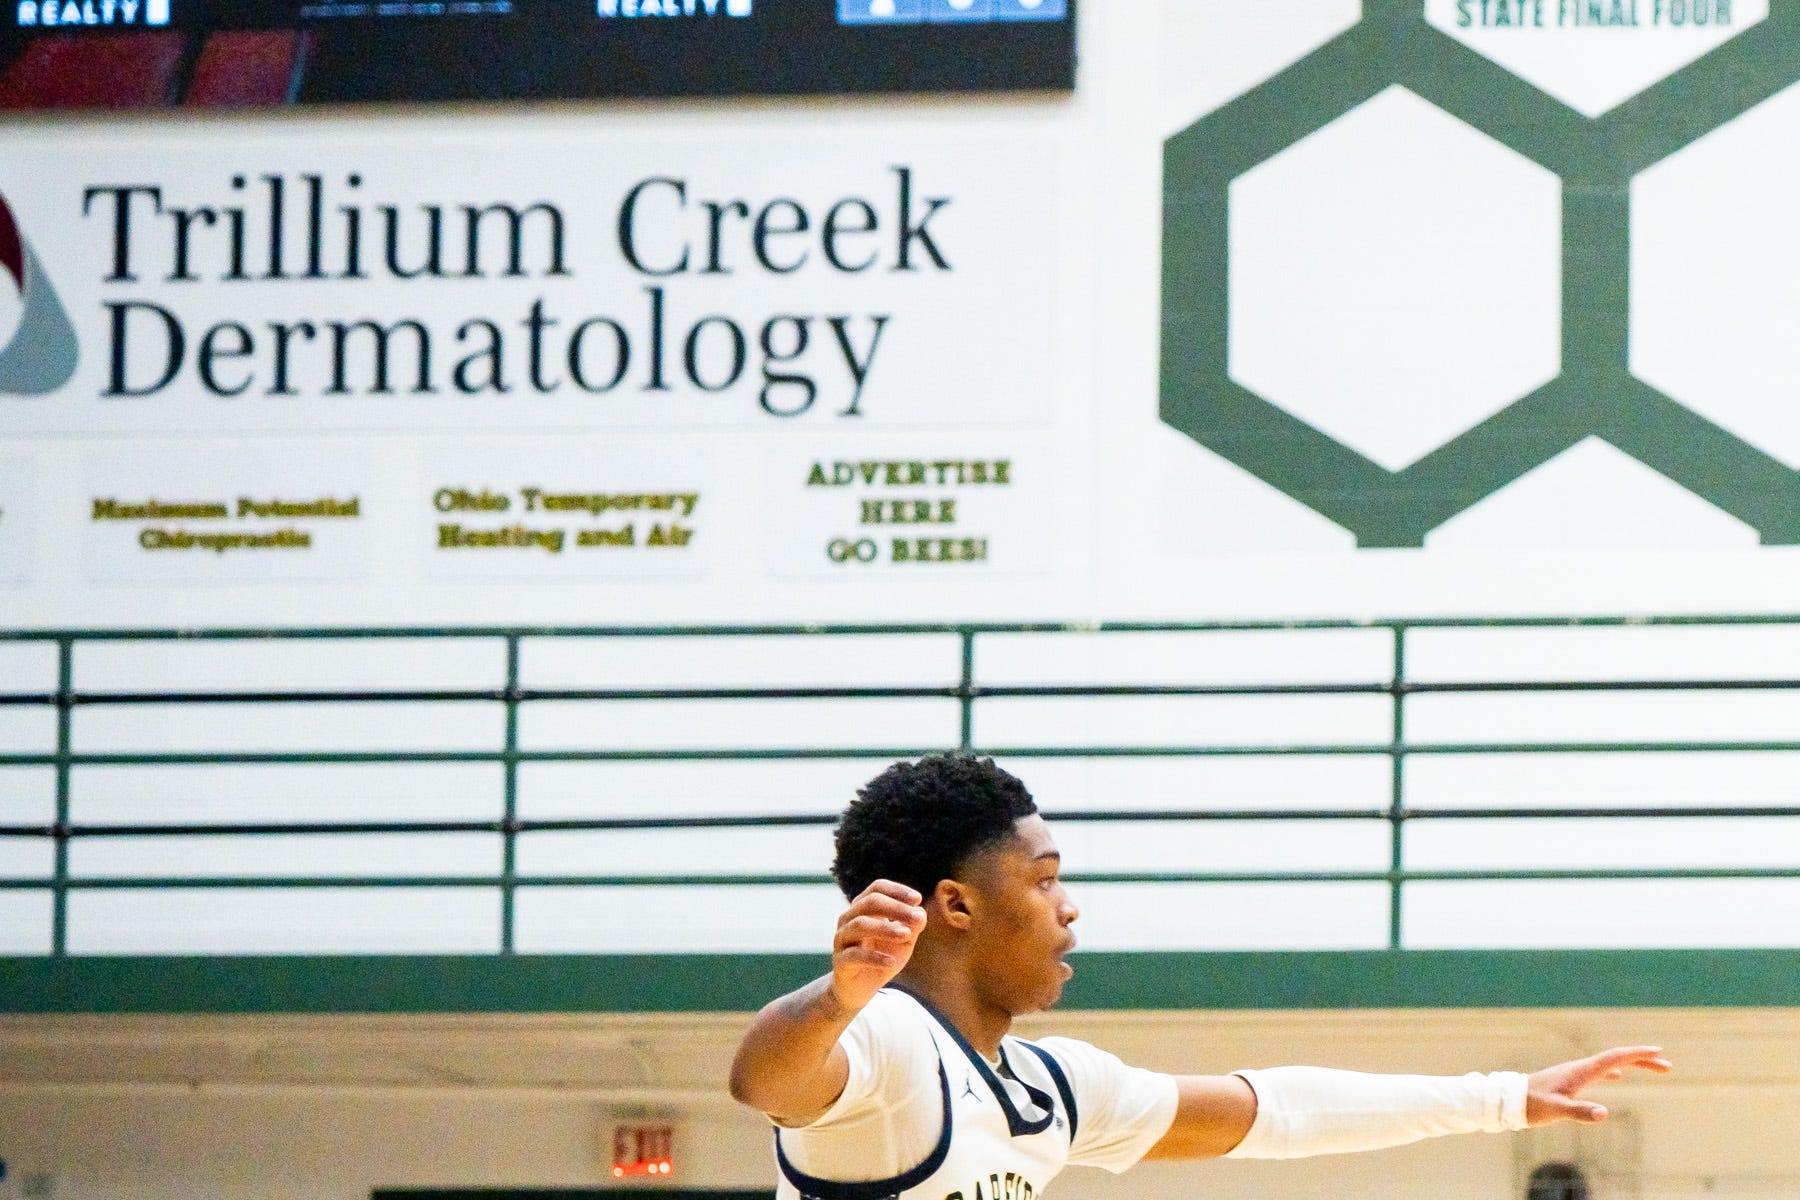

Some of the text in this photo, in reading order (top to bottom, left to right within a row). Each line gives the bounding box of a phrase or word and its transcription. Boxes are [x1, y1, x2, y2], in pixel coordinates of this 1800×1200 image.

[18, 0, 137, 25] REALTY
[1456, 0, 1732, 27] STATE FINAL FOUR
[83, 166, 955, 283] Trillium Creek
[100, 286, 889, 416] Dermatology
[806, 460, 1011, 486] ADVERTISE
[432, 488, 699, 517] Ohio Temporary
[859, 498, 956, 524] HERE
[575, 522, 635, 548] and
[826, 536, 988, 563] GO BEES!
